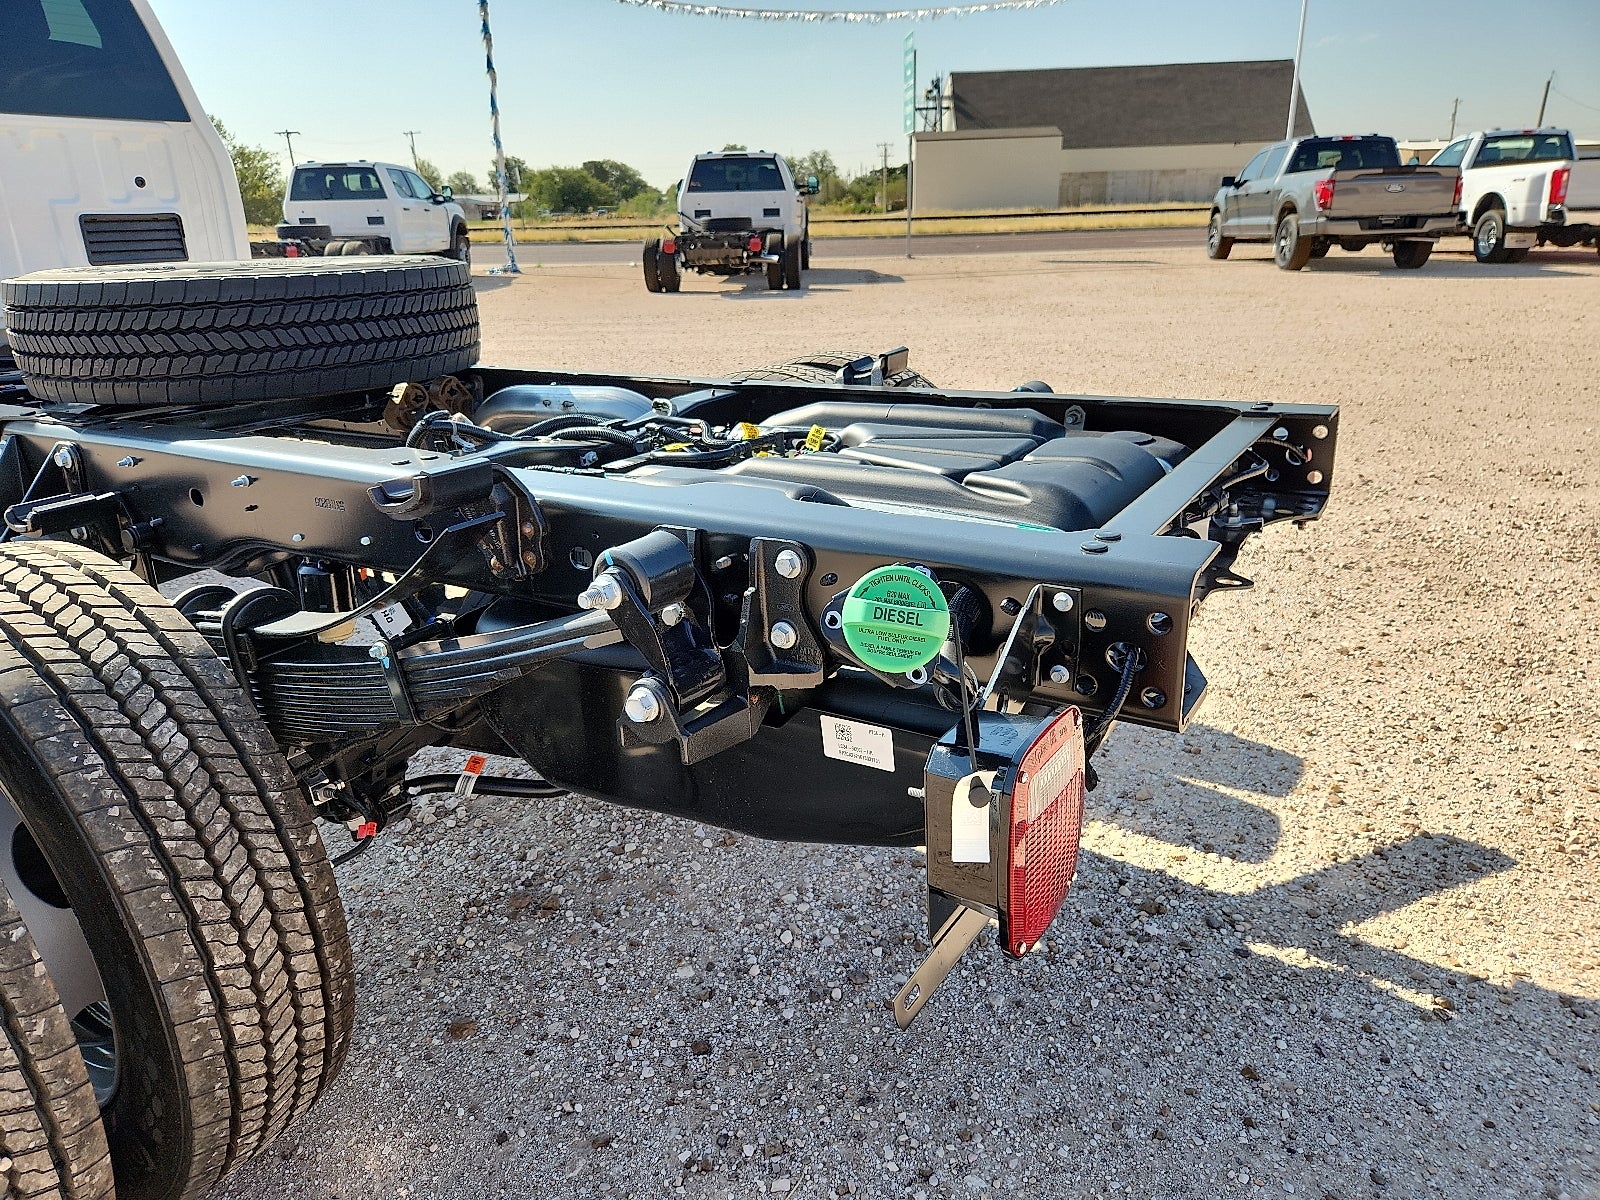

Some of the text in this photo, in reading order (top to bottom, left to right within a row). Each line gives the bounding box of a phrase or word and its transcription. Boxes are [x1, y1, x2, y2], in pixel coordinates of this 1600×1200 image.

[869, 575, 930, 597] TIGHTEN UNTIL CLICKS
[898, 591, 911, 600] MAX
[873, 607, 923, 626] DIESEL
[887, 632, 908, 640] SULFUR
[891, 637, 907, 645] ONLY
